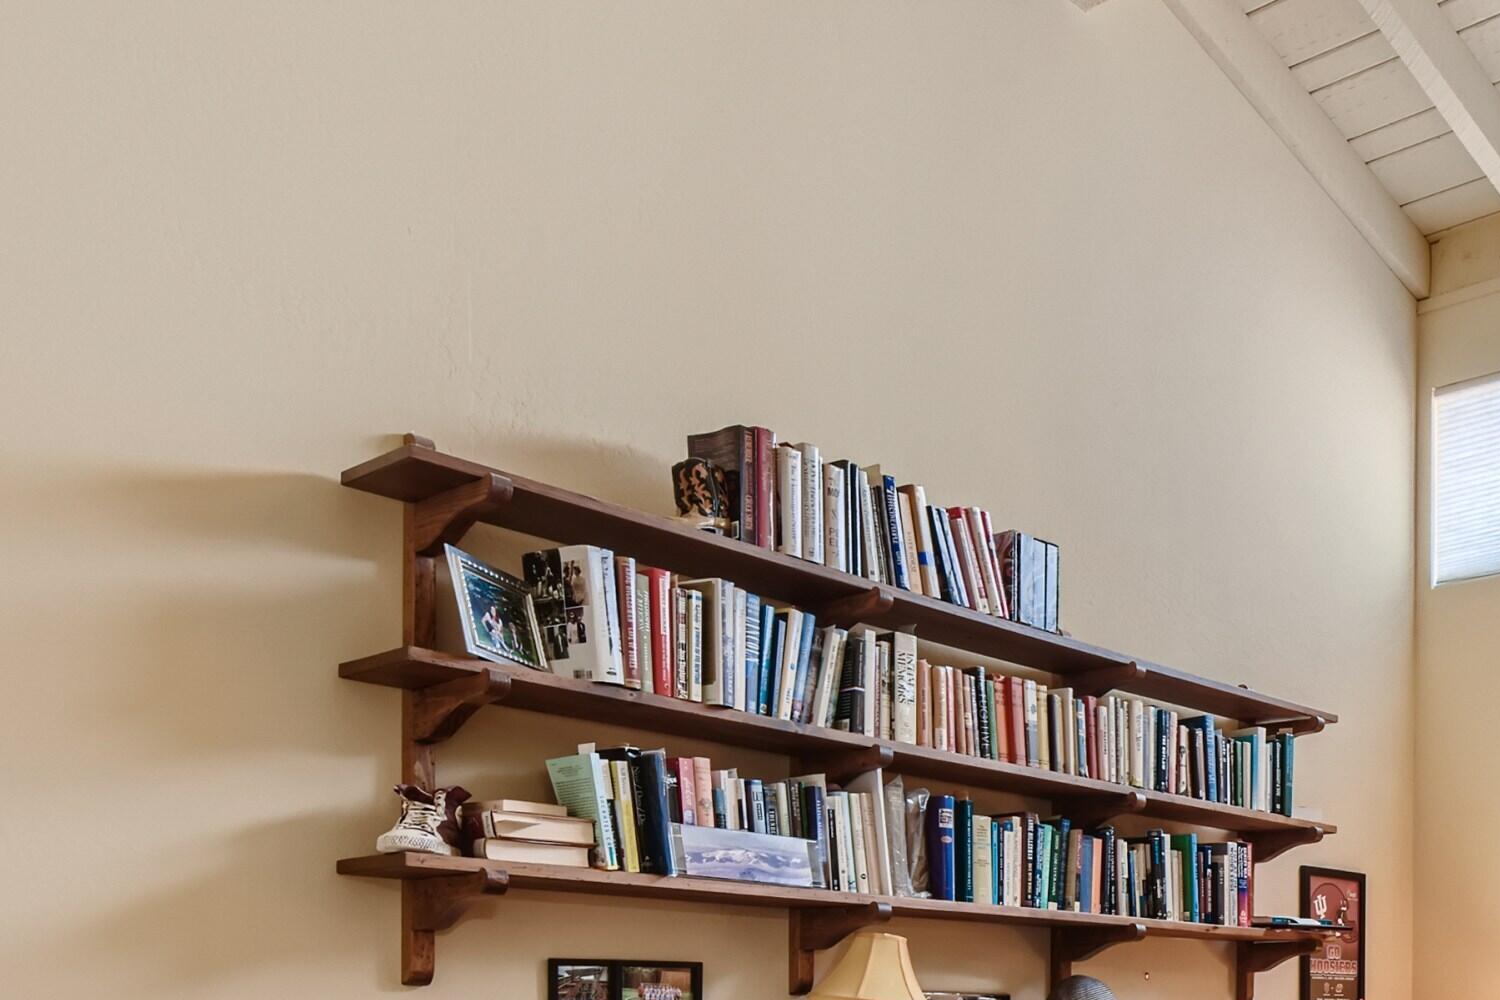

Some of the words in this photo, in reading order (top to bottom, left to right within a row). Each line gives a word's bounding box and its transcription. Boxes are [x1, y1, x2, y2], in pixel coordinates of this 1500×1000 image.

[897, 651, 906, 704] MEMOIRS
[1326, 945, 1341, 960] GO
[1310, 958, 1358, 975] HOOSIERS
